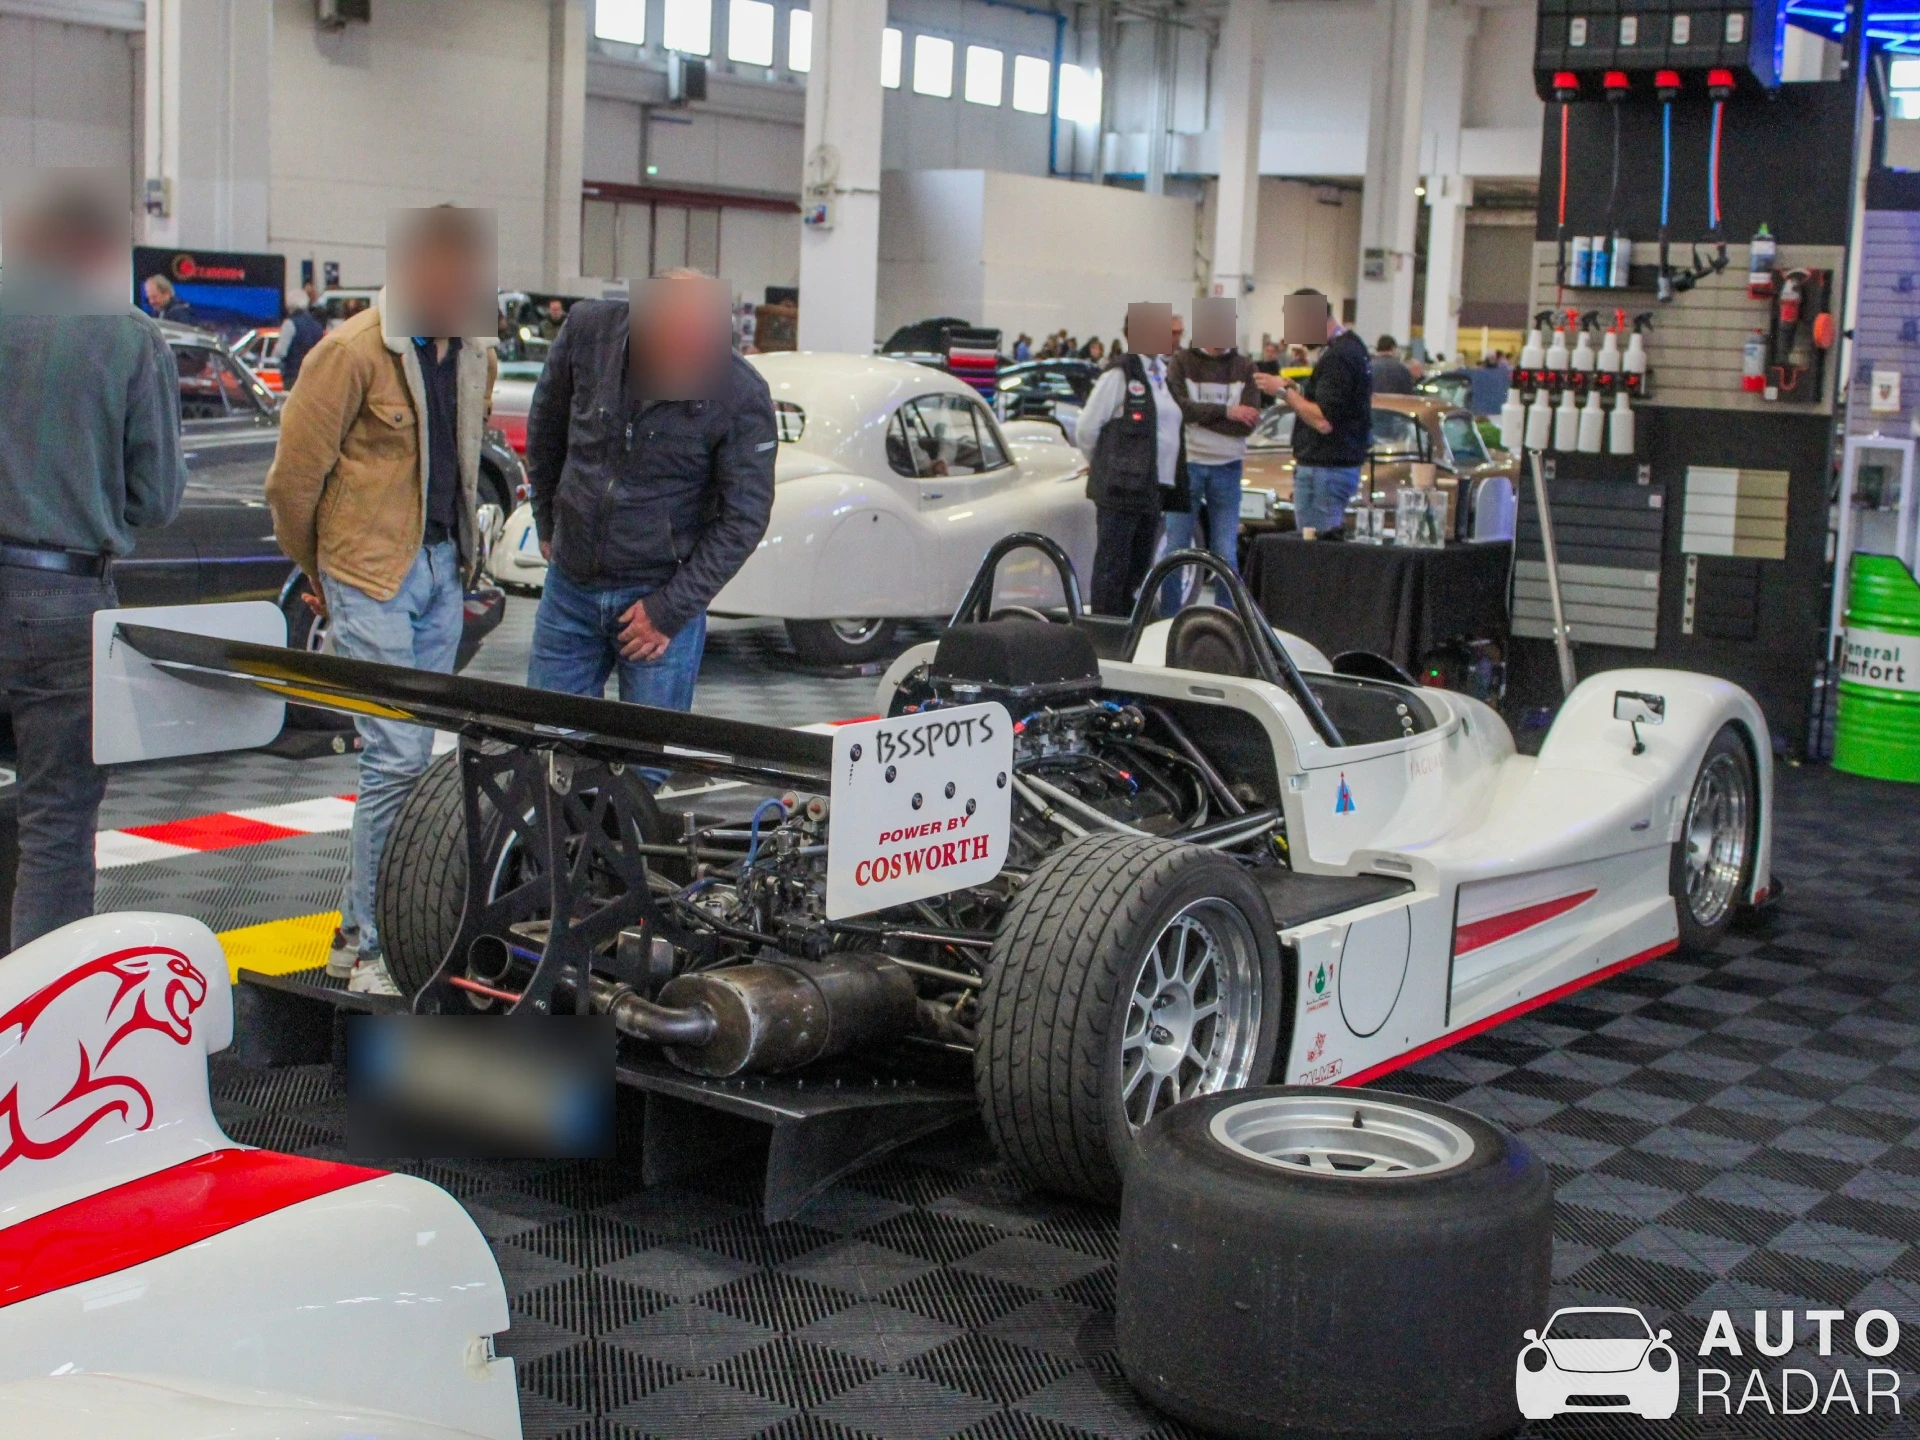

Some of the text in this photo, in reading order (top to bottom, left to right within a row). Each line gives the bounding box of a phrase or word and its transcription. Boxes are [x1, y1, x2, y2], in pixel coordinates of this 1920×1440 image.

[878, 815, 971, 846] POWER BY
[855, 834, 990, 887] COSWORTH
